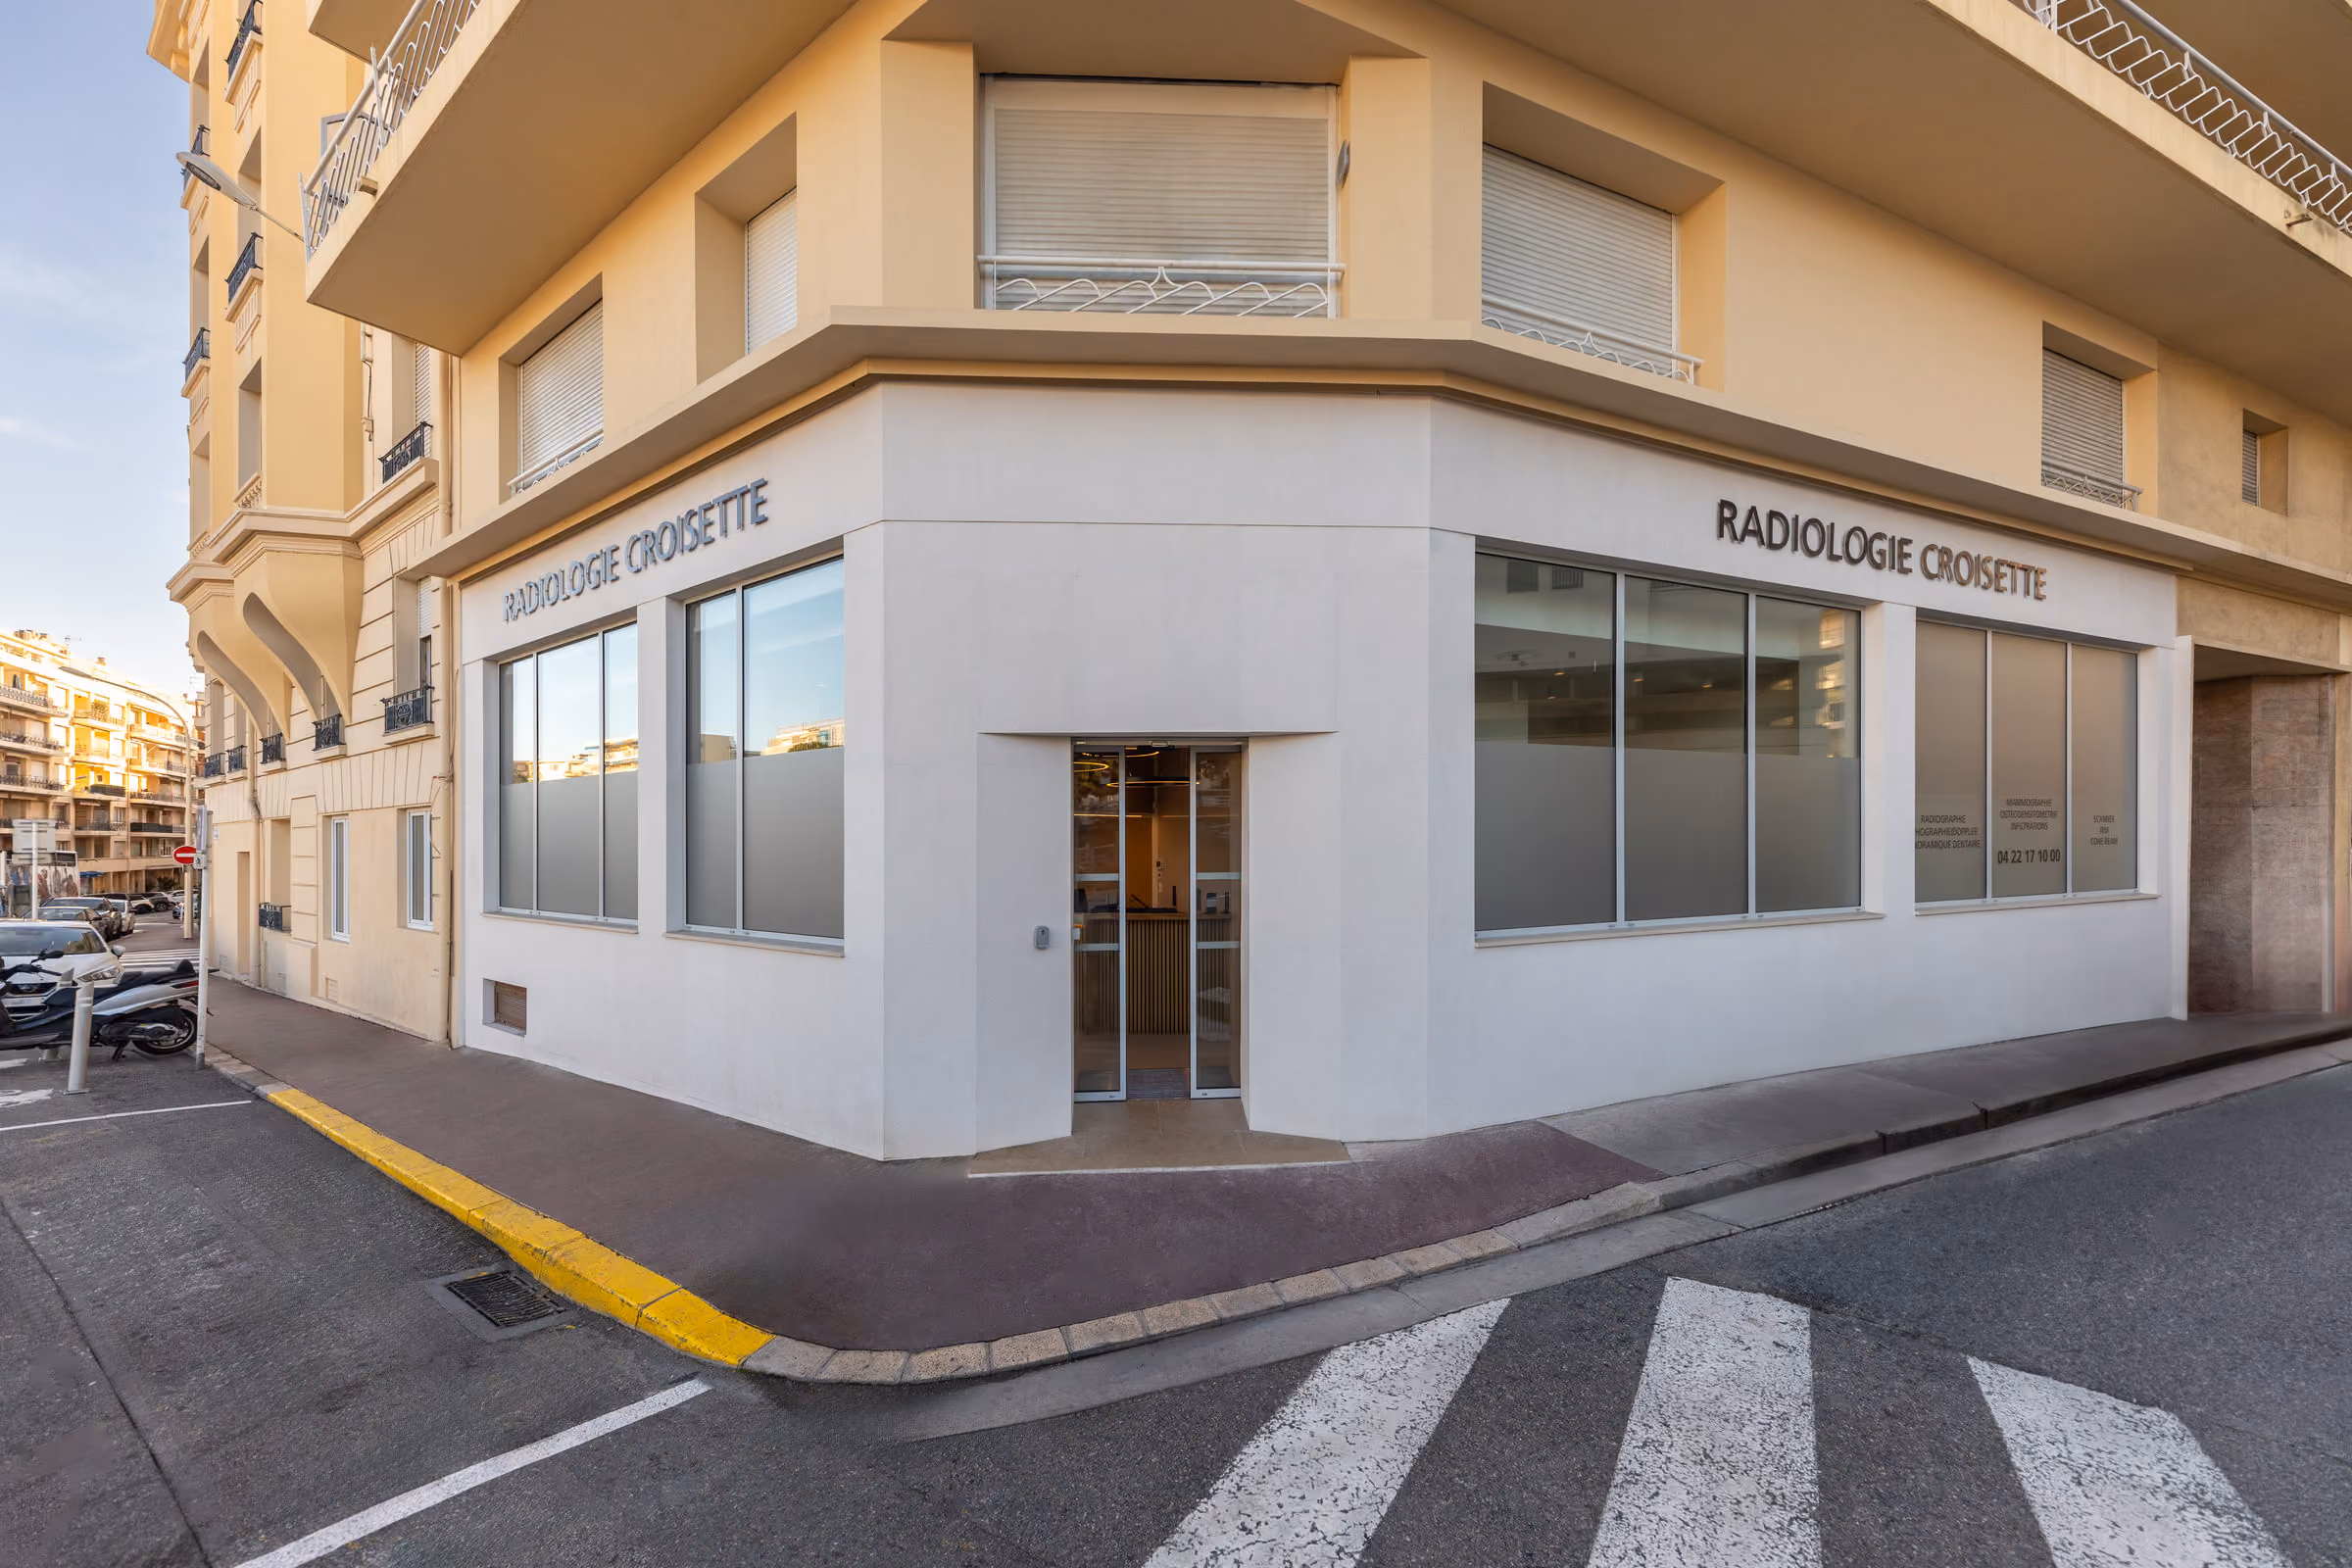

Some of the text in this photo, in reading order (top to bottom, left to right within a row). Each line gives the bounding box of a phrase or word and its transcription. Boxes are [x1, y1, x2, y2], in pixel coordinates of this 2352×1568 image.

[502, 477, 769, 623] RADIOLOGIE CROISETTE
[1717, 499, 2048, 601] RADIOLOGIE CROISETTE
[1921, 814, 1967, 824] RADIOGRAPHIE
[1952, 839, 1981, 849] DENTAIRE
[1997, 848, 2061, 864] 04 22 17 10 00
